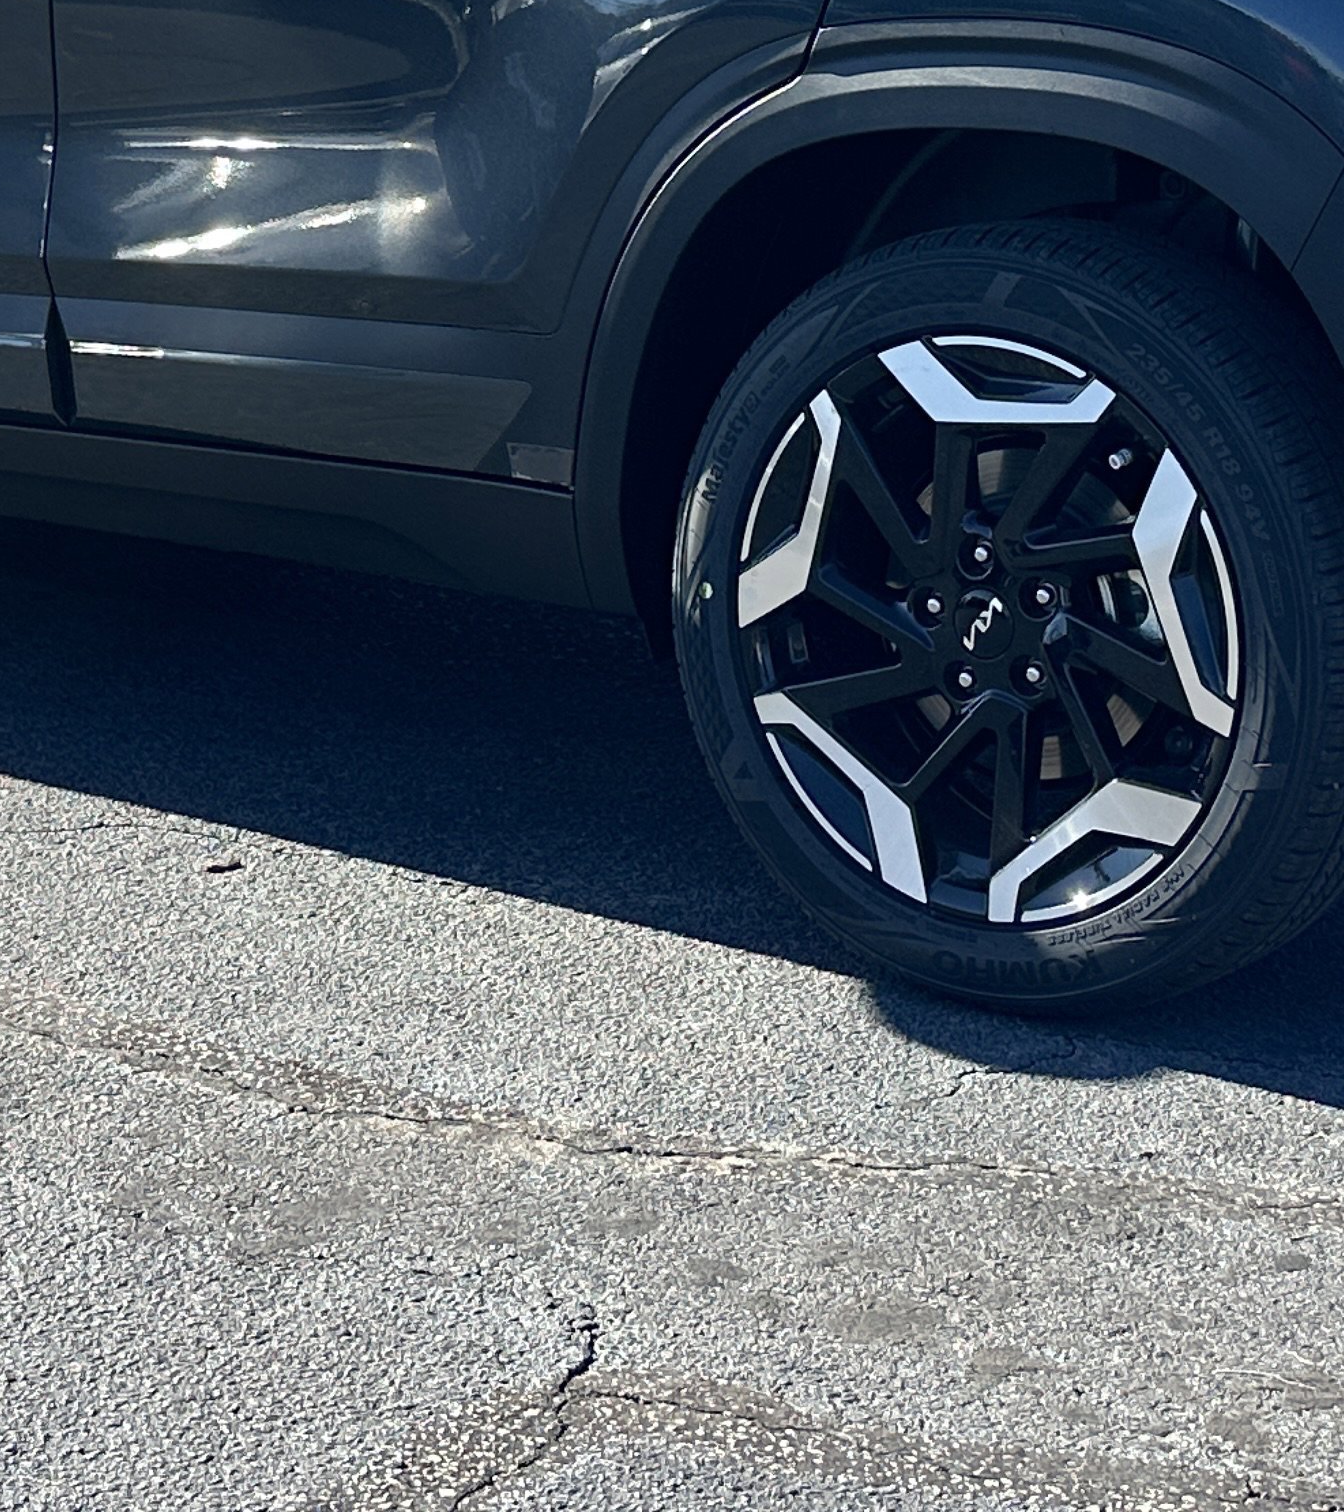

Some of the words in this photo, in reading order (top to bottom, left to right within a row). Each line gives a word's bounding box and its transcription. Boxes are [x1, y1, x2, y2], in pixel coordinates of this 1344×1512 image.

[1125, 343, 1206, 422] 235/45
[1202, 426, 1242, 476] R18
[932, 950, 1104, 986] KUMHO
